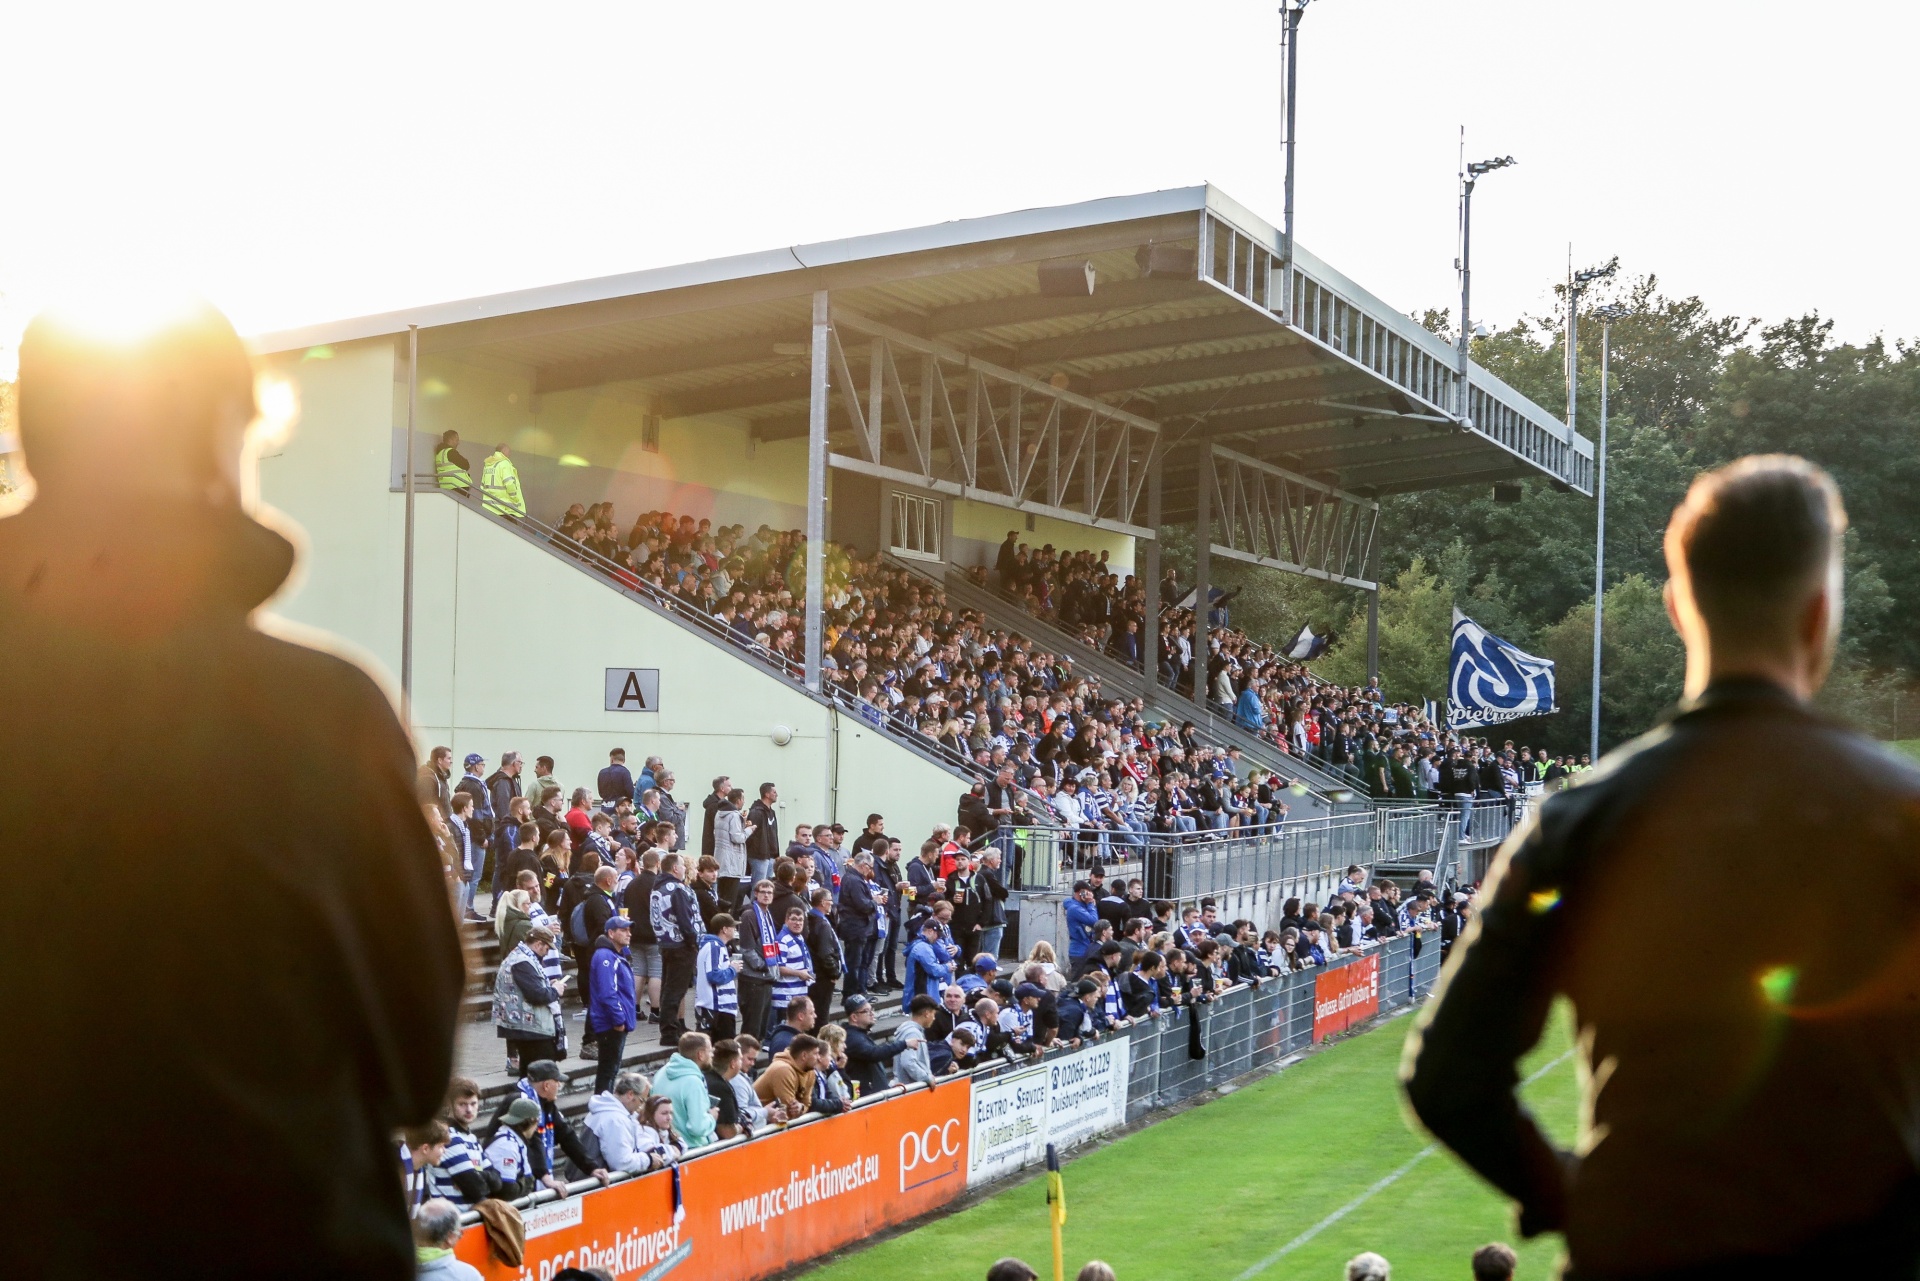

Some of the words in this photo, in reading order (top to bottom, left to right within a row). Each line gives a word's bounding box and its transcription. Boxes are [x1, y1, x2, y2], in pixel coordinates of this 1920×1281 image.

[617, 671, 646, 708] A
[1051, 1079, 1110, 1114] Duisburg-Homberg
[899, 1118, 961, 1194] pcc
[720, 1153, 880, 1236] www.pcc-direktinvest.eu
[579, 1224, 680, 1277] Direktinvest
